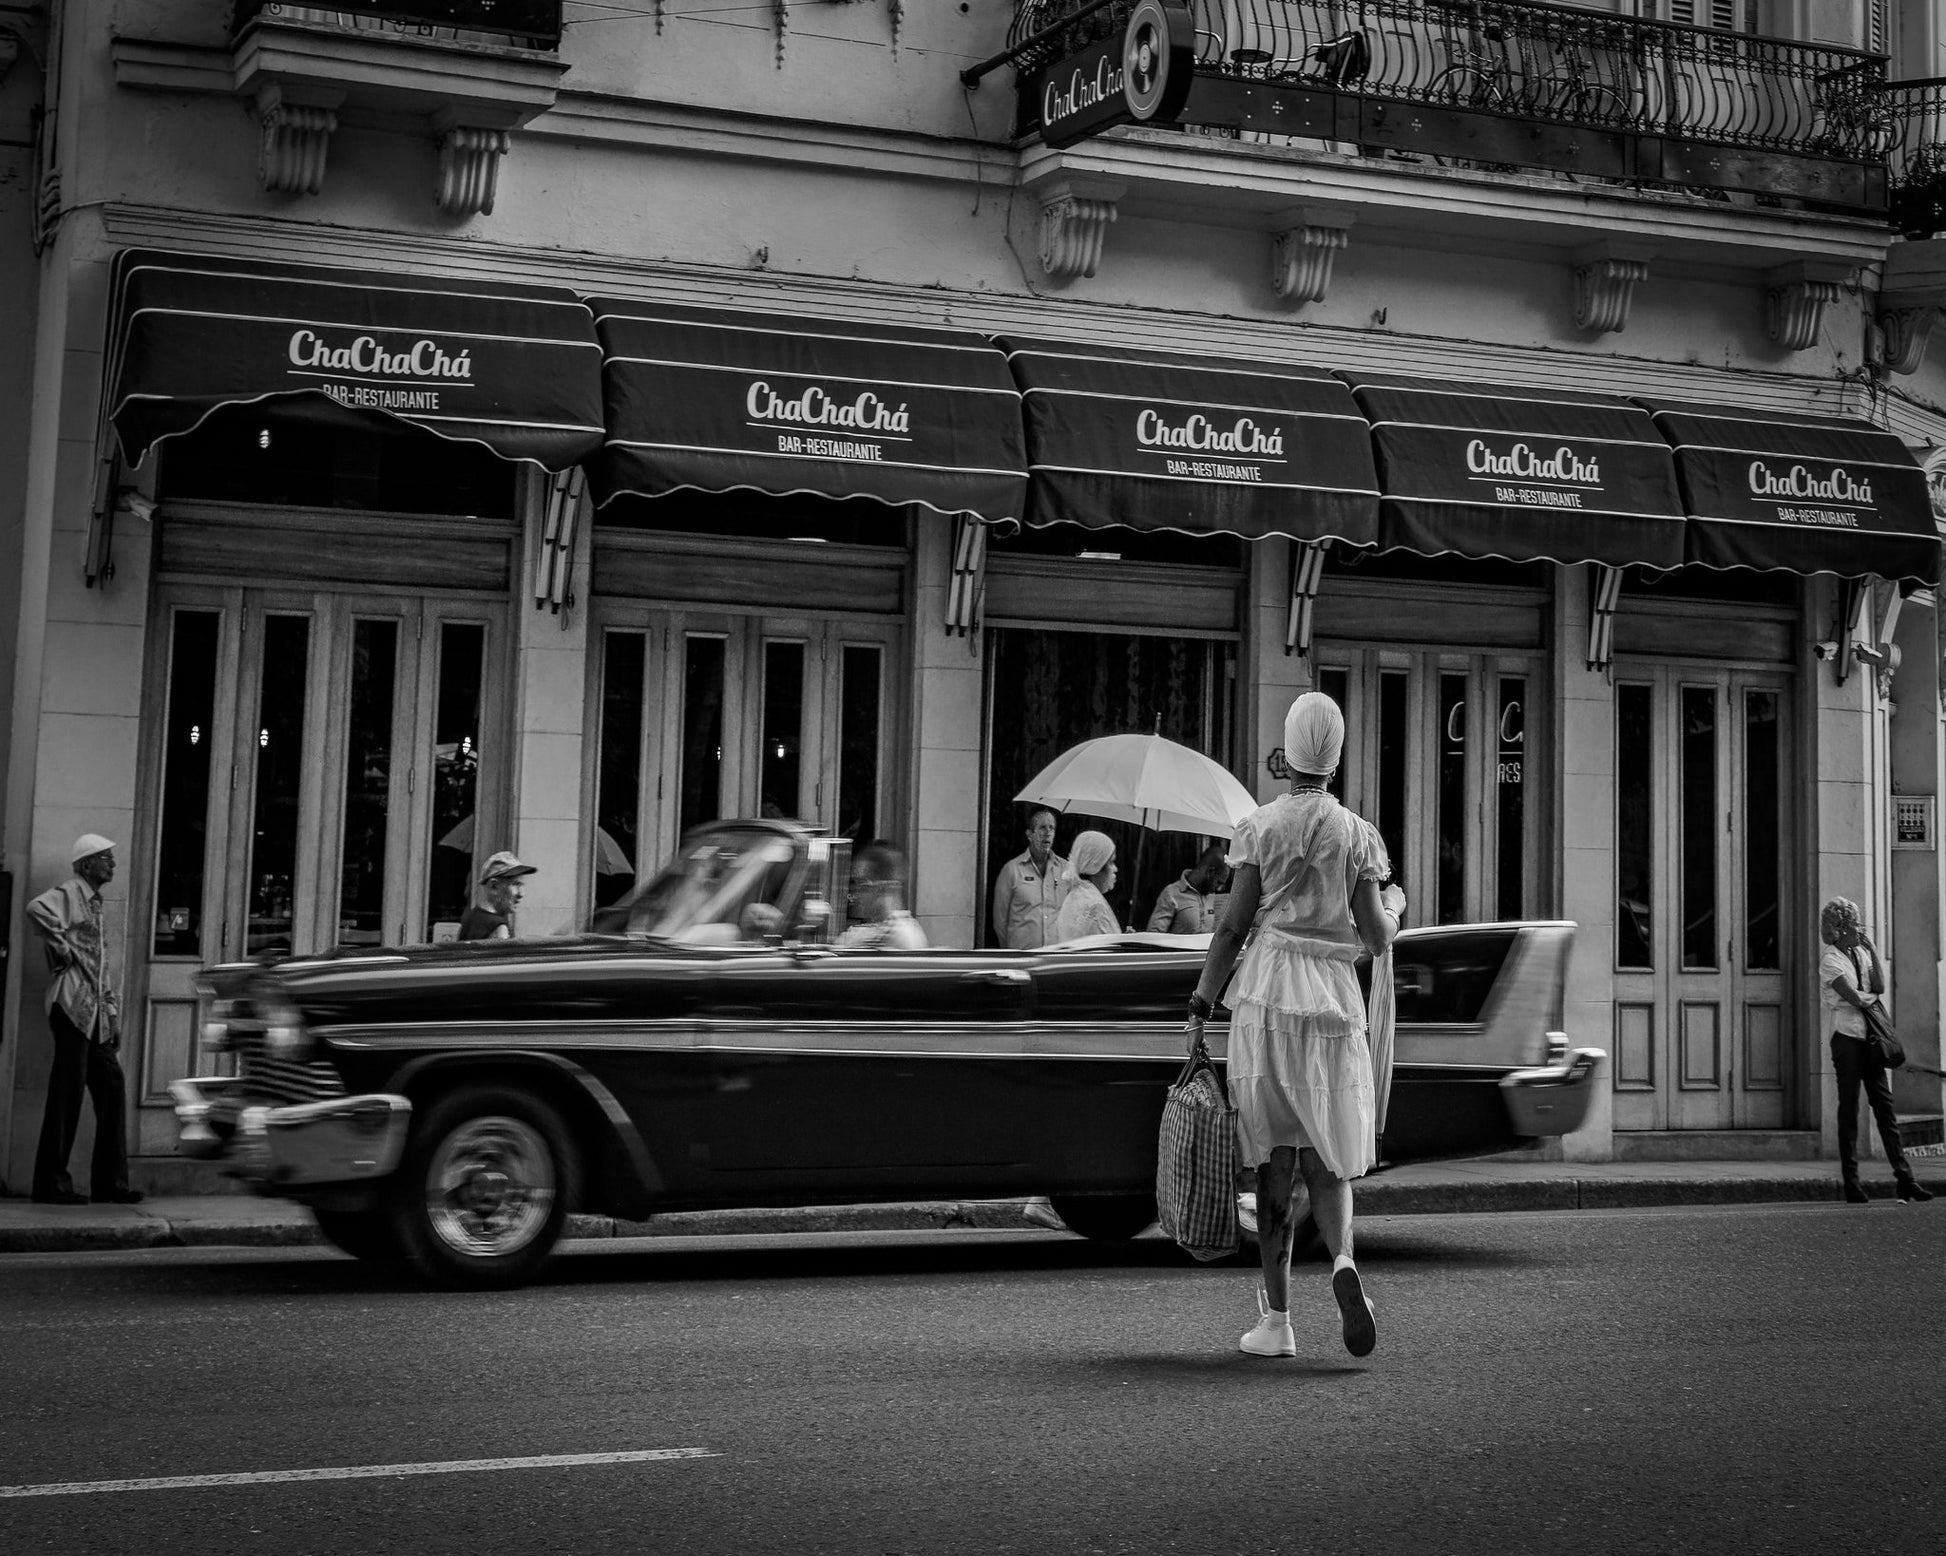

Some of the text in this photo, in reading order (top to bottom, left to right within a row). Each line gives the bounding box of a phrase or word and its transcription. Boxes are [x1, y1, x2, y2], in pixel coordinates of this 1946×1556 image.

[289, 330, 471, 377] ChaChaChá
[747, 381, 909, 432] ChaChaChá
[778, 435, 882, 460] BAR-RESTAURANTE
[1137, 409, 1284, 455] ChaChaChá
[1166, 459, 1262, 481] BAR-RESTAURANTE
[1467, 439, 1600, 483] ChaChaChá
[1749, 461, 1873, 503] ChaChaChá
[1495, 487, 1583, 508] BAR-RESTAURANTE
[1777, 507, 1859, 527] BAR-RESTAURANTE
